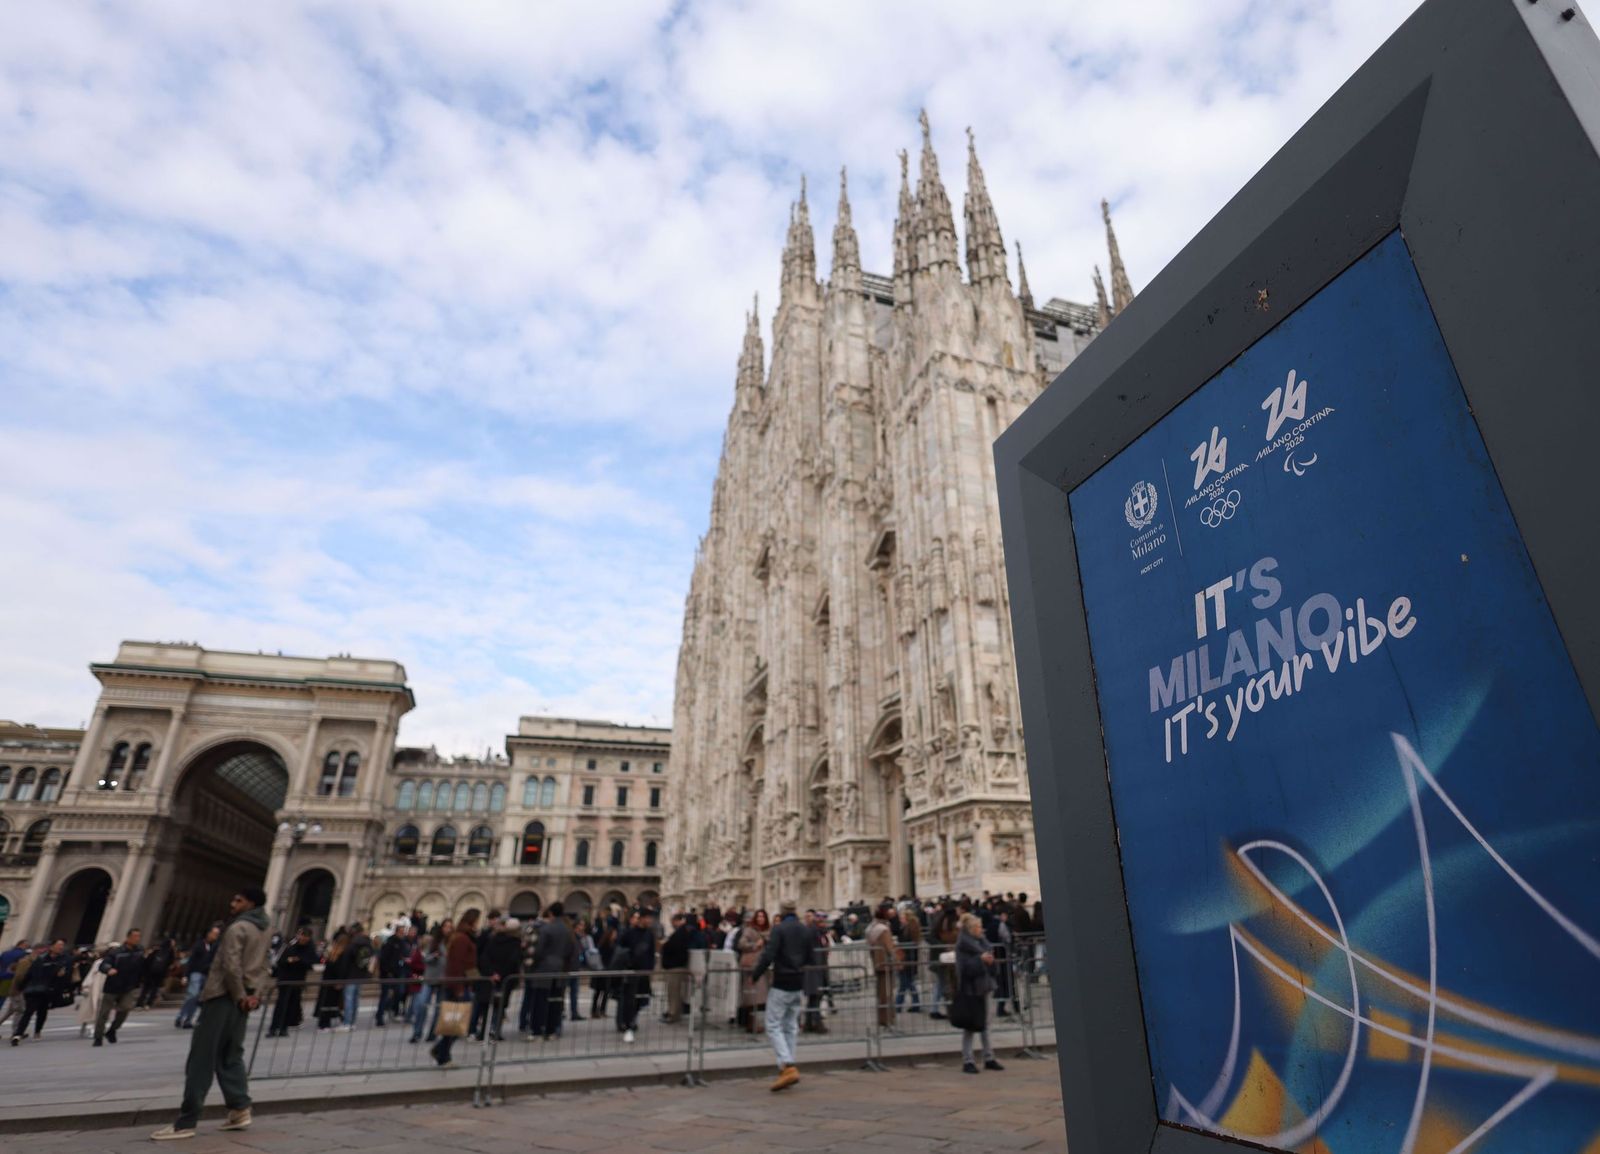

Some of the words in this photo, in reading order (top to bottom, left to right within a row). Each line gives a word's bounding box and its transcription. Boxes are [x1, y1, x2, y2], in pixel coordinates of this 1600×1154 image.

[1255, 432, 1292, 462] MILANO
[1292, 407, 1336, 436] CORTINA
[1284, 434, 1305, 452] 2026
[1185, 483, 1214, 509] MILANO
[1214, 463, 1249, 487] CORTINA
[1208, 485, 1225, 501] 2026
[1130, 526, 1157, 549] Comune
[1132, 533, 1166, 560] Milano
[1140, 563, 1153, 575] HOST
[1153, 557, 1164, 568] CITY
[1195, 557, 1282, 640] IT'S
[1149, 593, 1343, 713] MILANO
[1226, 653, 1314, 742] your
[1321, 596, 1417, 673] vibe
